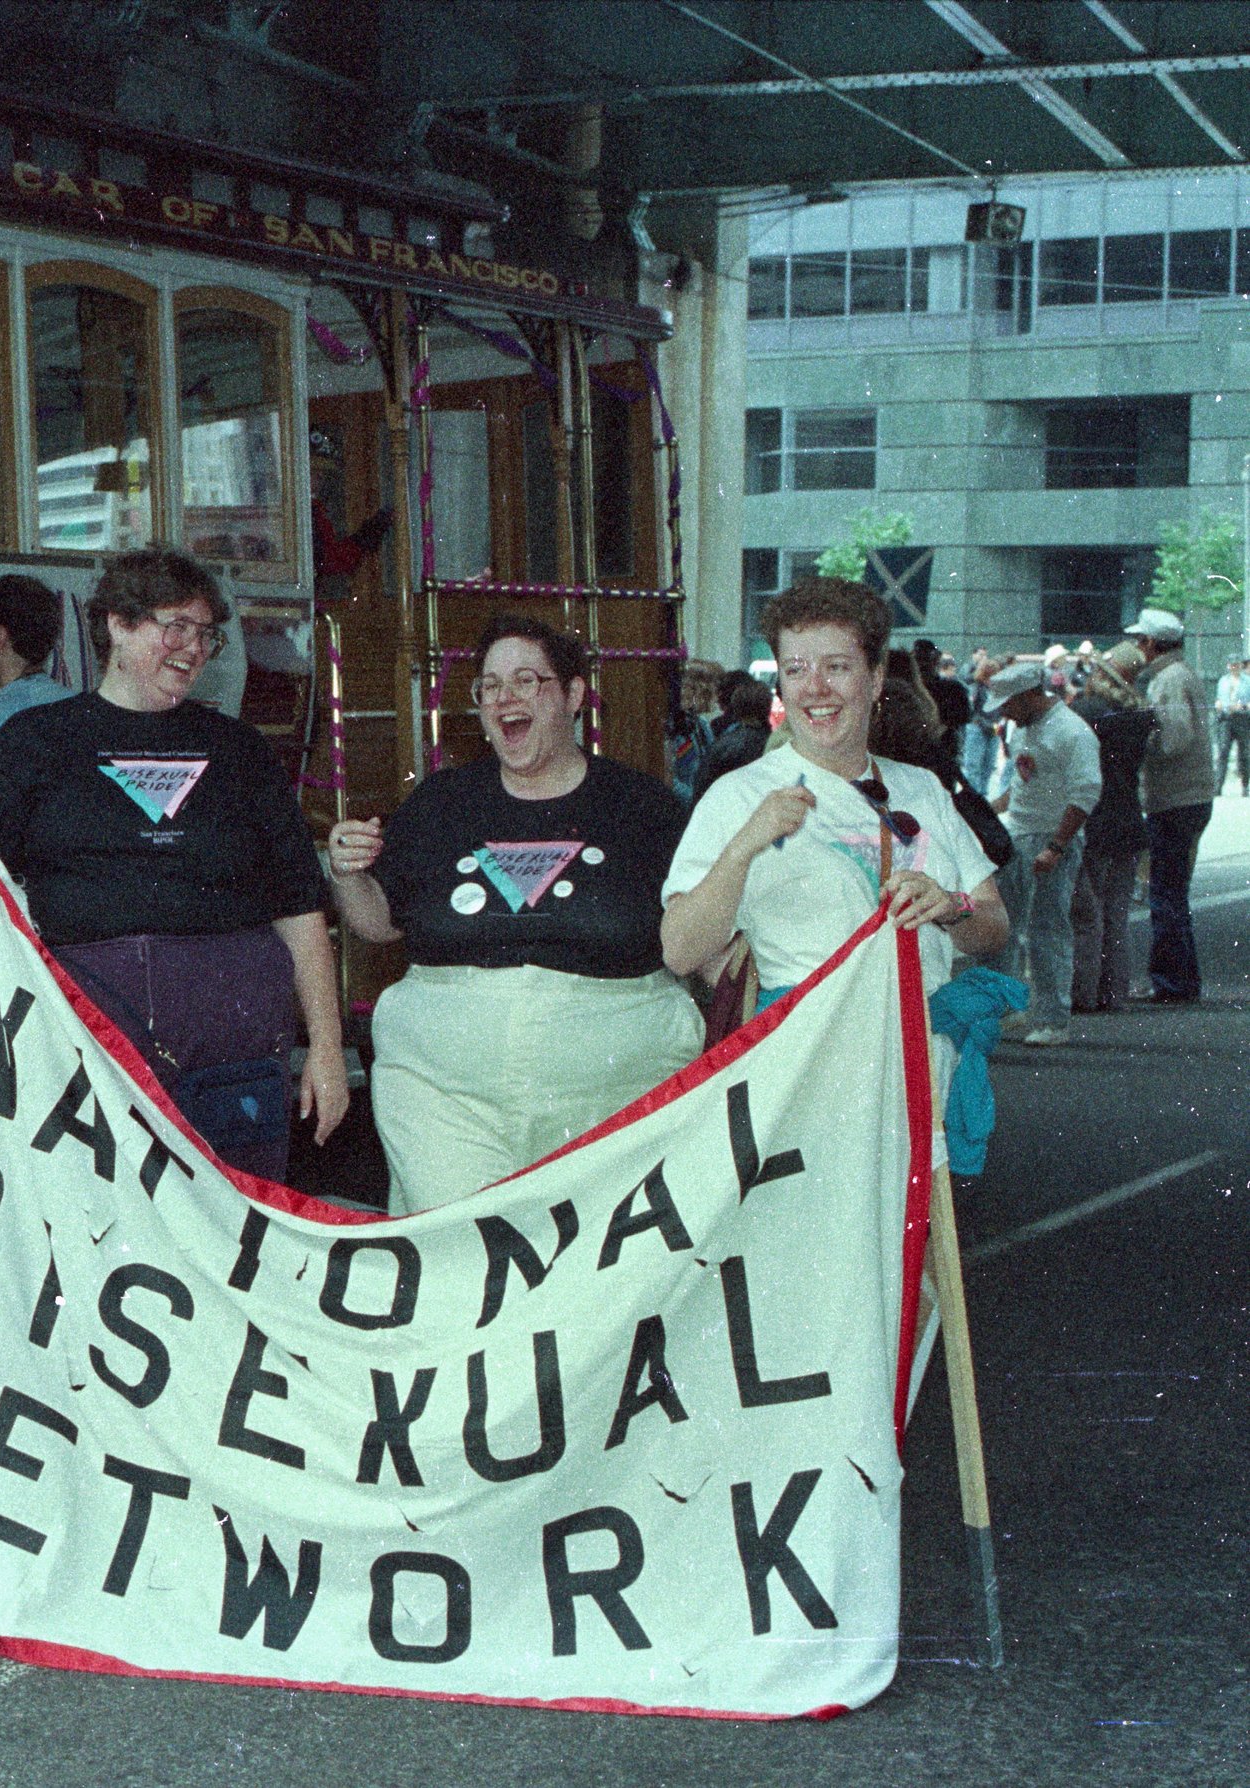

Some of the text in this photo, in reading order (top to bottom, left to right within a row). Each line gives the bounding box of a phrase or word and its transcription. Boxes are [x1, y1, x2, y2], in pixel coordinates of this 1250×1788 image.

[12, 161, 124, 215] CAR
[161, 195, 219, 226] OF
[262, 214, 355, 256] SAN
[370, 236, 559, 294] FRANCISCO
[116, 768, 199, 781] BISEXUAL
[484, 851, 570, 864] BISEXUAL
